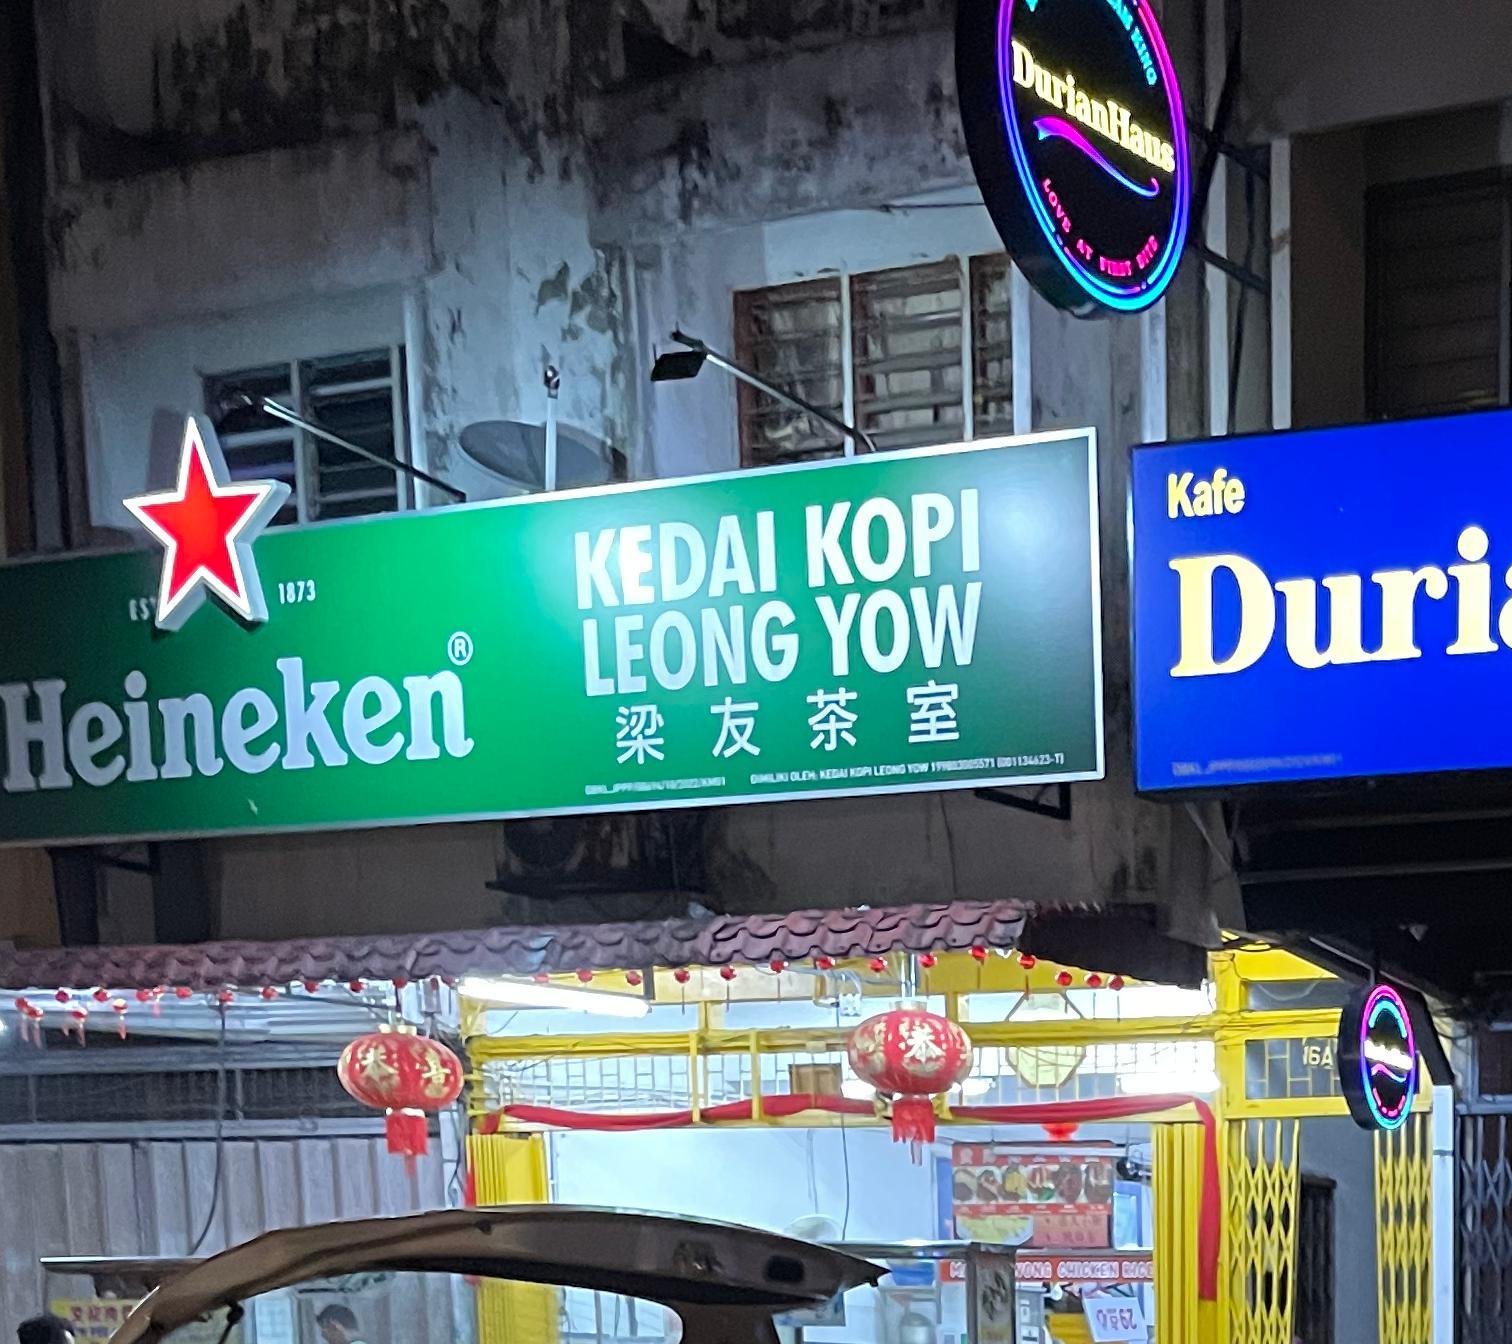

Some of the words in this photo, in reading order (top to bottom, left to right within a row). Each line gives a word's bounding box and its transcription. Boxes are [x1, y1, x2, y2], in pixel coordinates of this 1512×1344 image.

[1011, 39, 1176, 173] DurianHaus
[574, 514, 775, 611] KEDAI
[805, 486, 980, 579] KOPI
[1166, 470, 1246, 518] Kafe
[278, 579, 316, 604] 1873
[583, 600, 799, 697] LEONG
[825, 581, 981, 677] YOW
[2, 655, 474, 793] Heineken
[1057, 1261, 1120, 1279] CHICKEN
